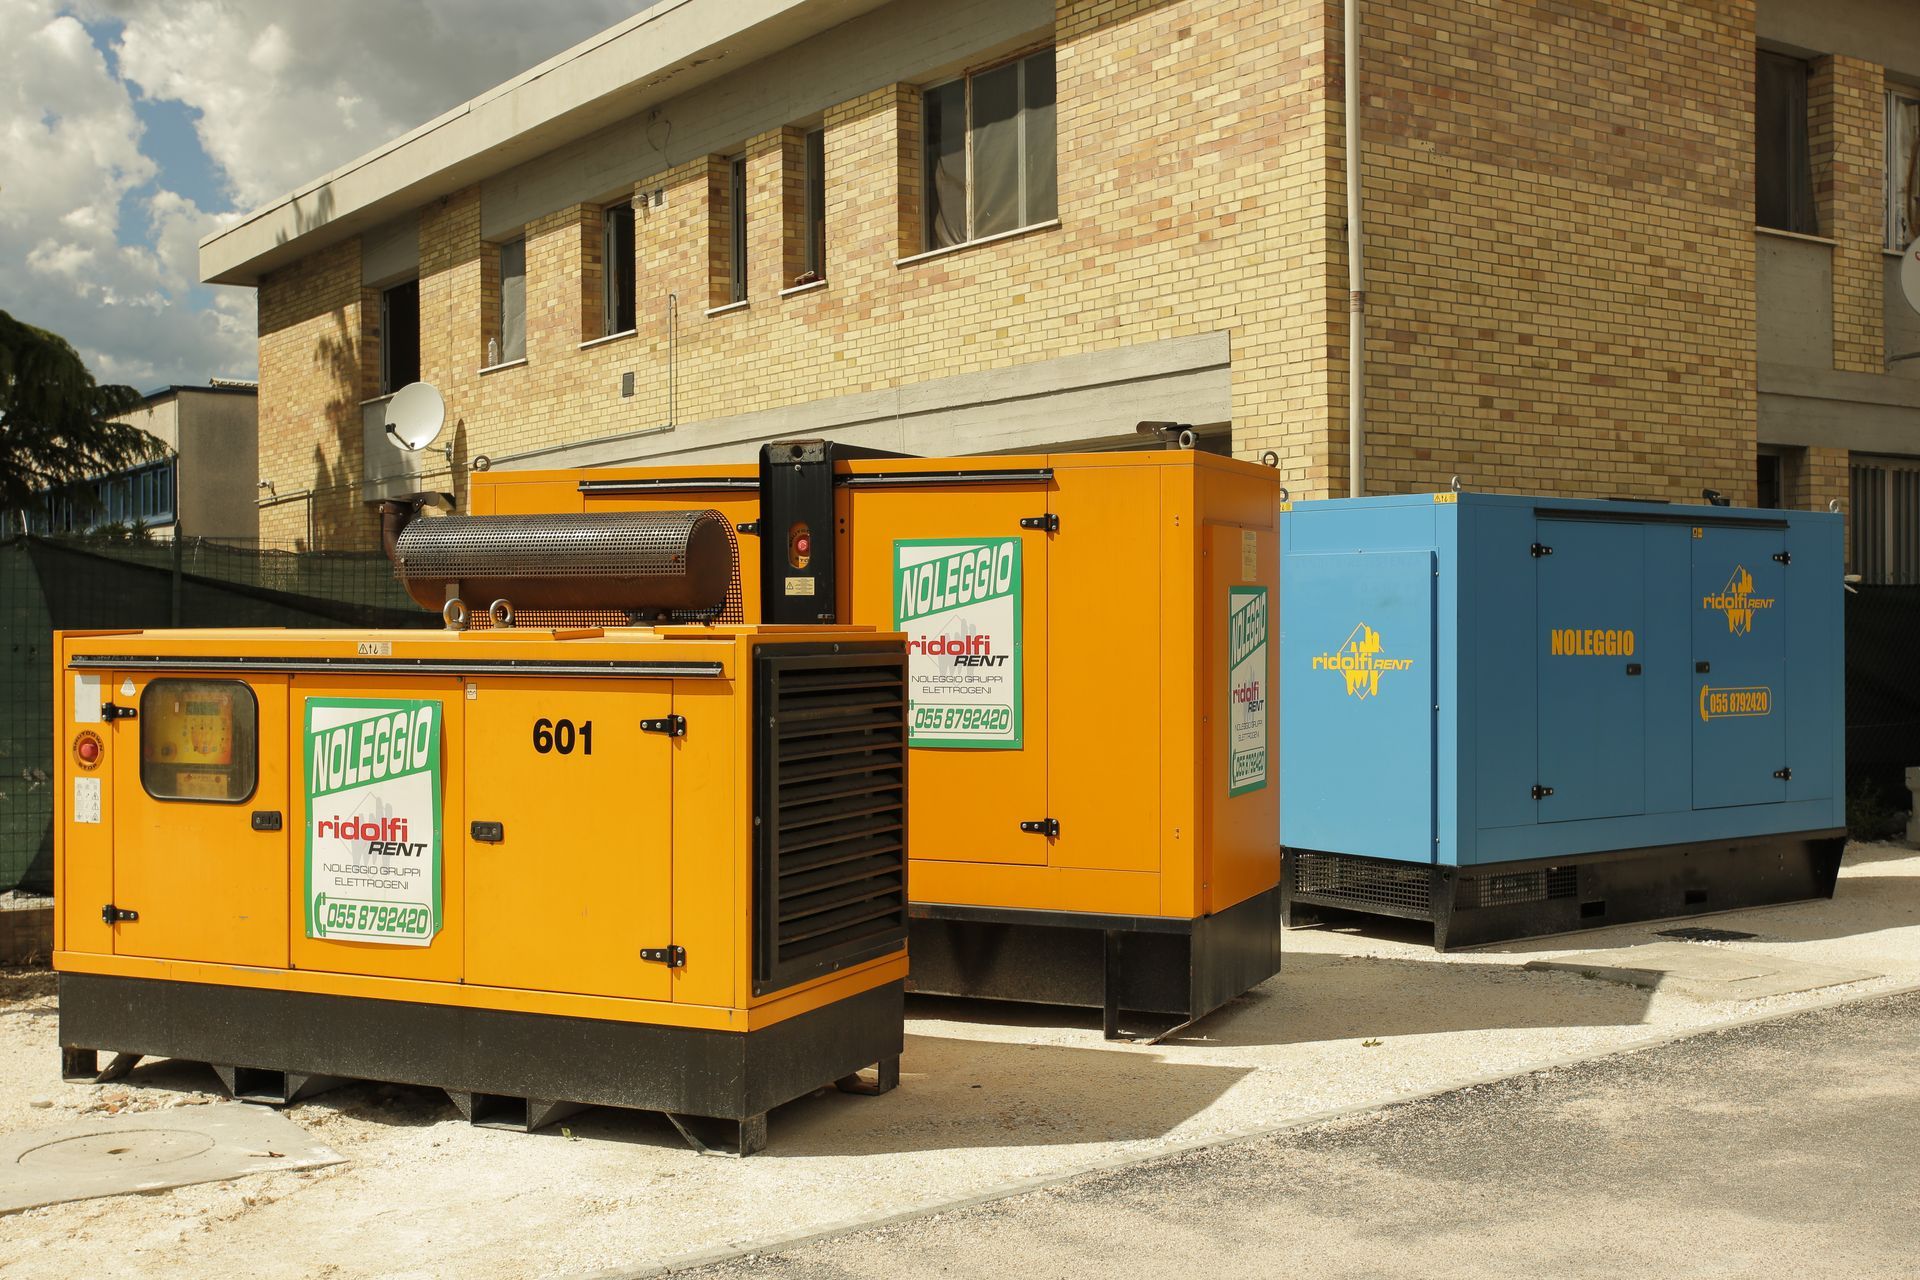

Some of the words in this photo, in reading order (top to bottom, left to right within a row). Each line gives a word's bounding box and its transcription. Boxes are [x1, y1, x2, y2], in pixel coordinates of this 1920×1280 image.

[900, 541, 1014, 619] NOLEGGIO
[1703, 592, 1747, 609] ridolfi
[1748, 599, 1775, 609] RENT
[1231, 591, 1266, 667] NOLEGGIO
[906, 635, 990, 655] ridolfi
[1551, 629, 1634, 656] NOLEGGIO
[954, 655, 1009, 667] RENT
[1312, 652, 1372, 670] ridolfi
[1374, 659, 1413, 670] RENT
[912, 675, 963, 683] NOLEGGIO
[965, 675, 1003, 684] GRUPPI
[922, 686, 992, 694] ELETTROGENI
[1232, 682, 1260, 704] ridolfi
[1710, 693, 1728, 713] 055
[1729, 691, 1767, 712] 8792420
[1248, 700, 1264, 713] RENT
[915, 708, 943, 729] 055
[944, 709, 1010, 730] 8792420
[533, 718, 592, 755] 601
[312, 706, 432, 794] NOLEGGIO
[318, 815, 407, 842] ridolfi
[368, 842, 427, 857] RENT
[323, 863, 378, 875] NOLEGGIO
[380, 866, 421, 877] GRUPPI
[335, 877, 408, 890] ELETTROGENI
[327, 903, 357, 929] 055
[358, 905, 428, 934] 8792420
